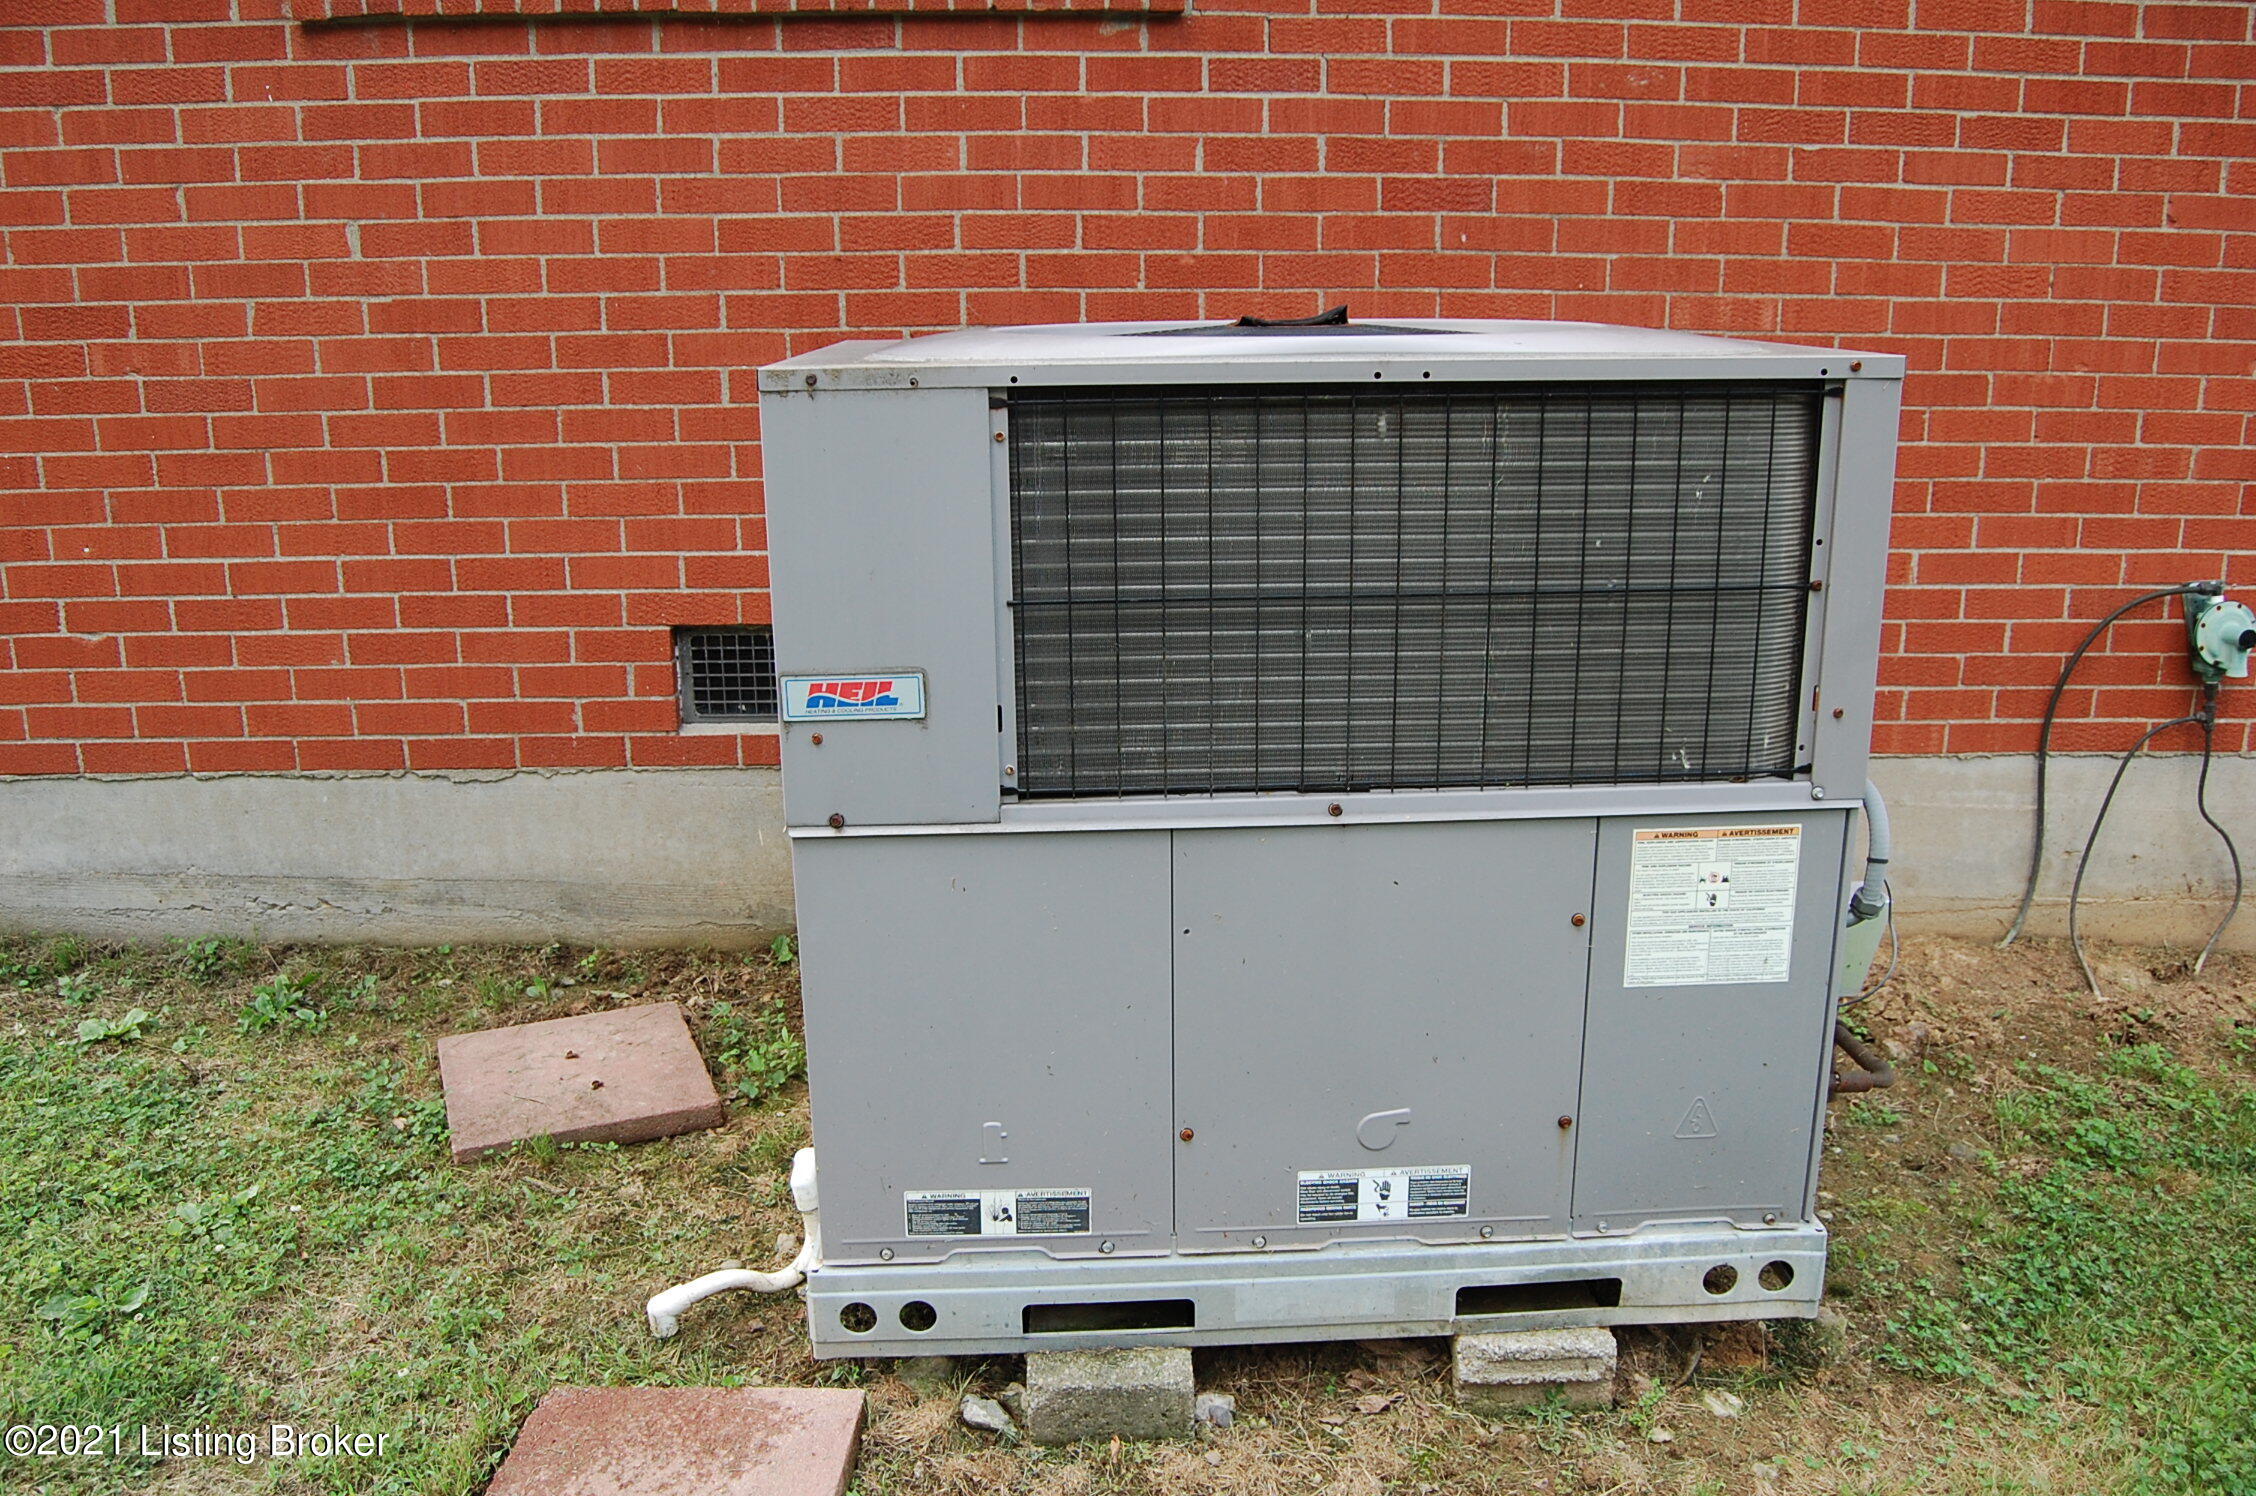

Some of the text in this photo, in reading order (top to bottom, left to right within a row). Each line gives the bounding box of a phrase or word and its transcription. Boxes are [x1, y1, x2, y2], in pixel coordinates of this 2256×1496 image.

[806, 681, 899, 708] HEIL
[1729, 828, 1794, 836] AVERTISSEMENT
[1400, 1167, 1463, 1175] AVERTISSEMENT
